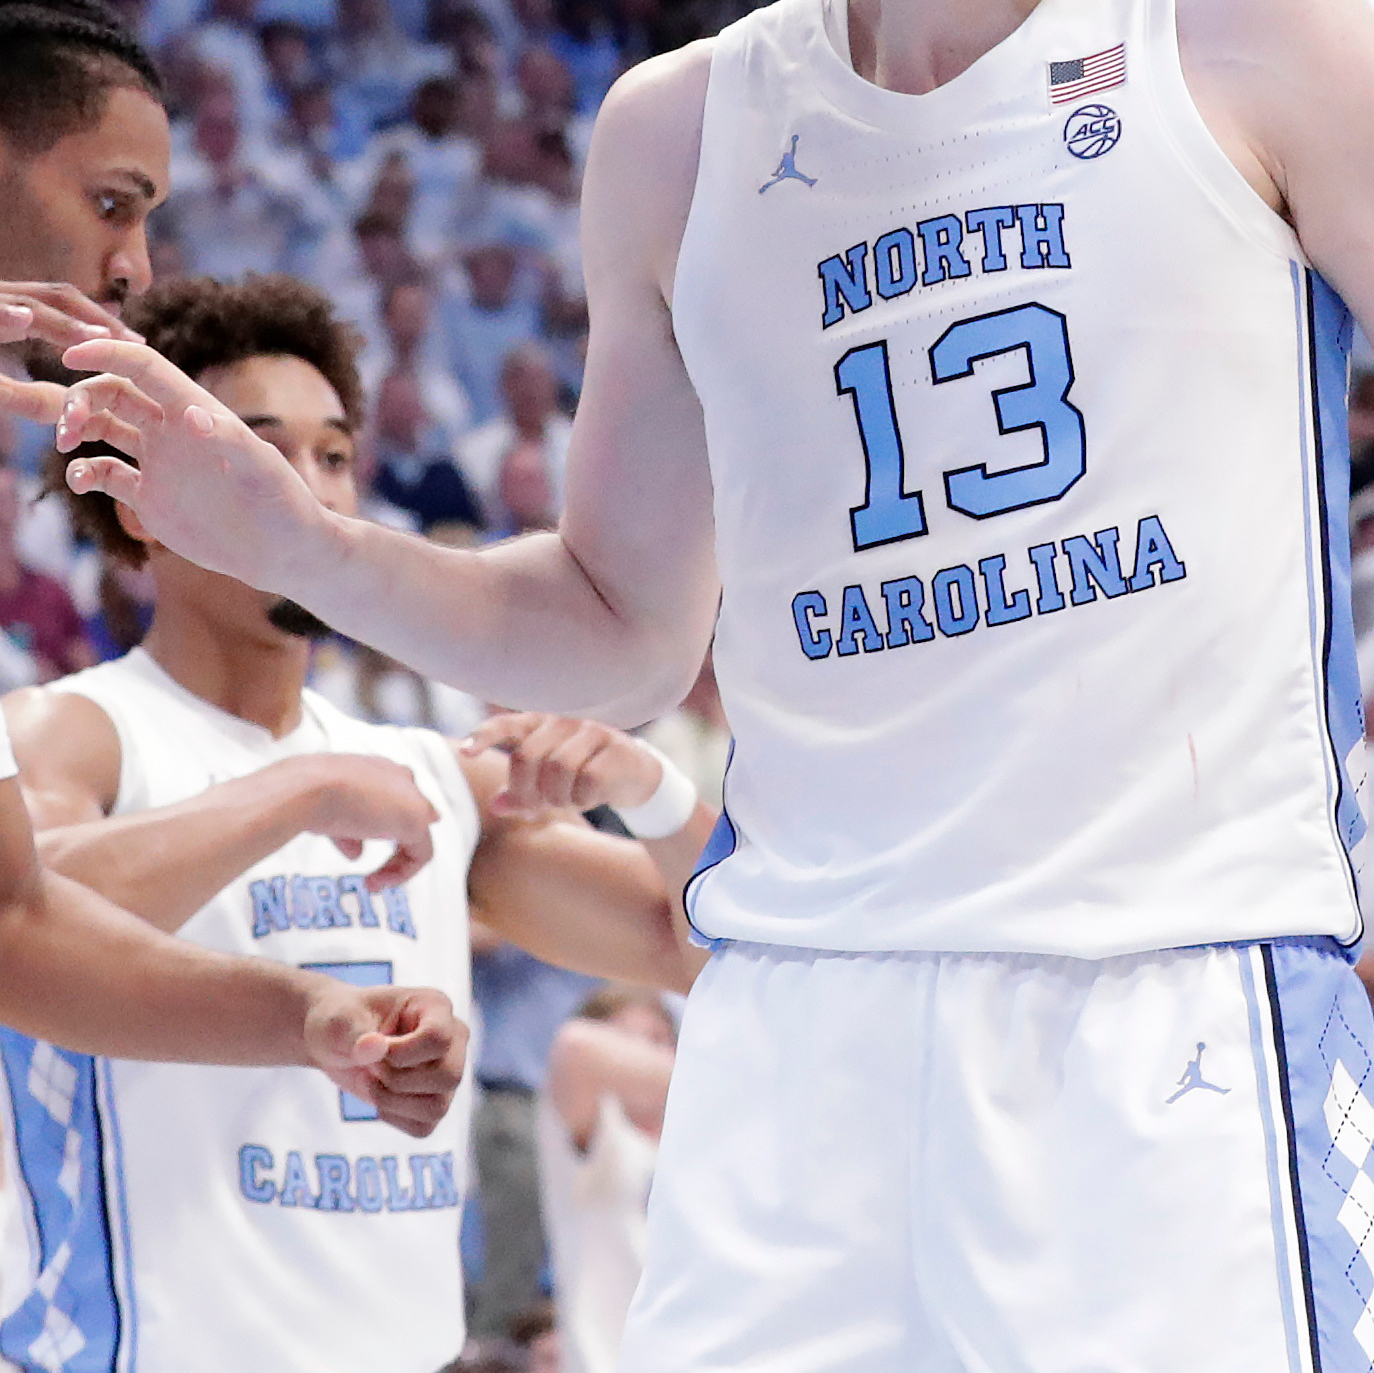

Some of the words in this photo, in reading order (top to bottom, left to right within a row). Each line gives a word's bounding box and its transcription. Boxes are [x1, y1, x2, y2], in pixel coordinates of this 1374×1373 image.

[817, 203, 1072, 331] NORTH
[833, 301, 1087, 553] 13
[791, 514, 1187, 661] CAROLINA
[250, 874, 417, 939] NORTH
